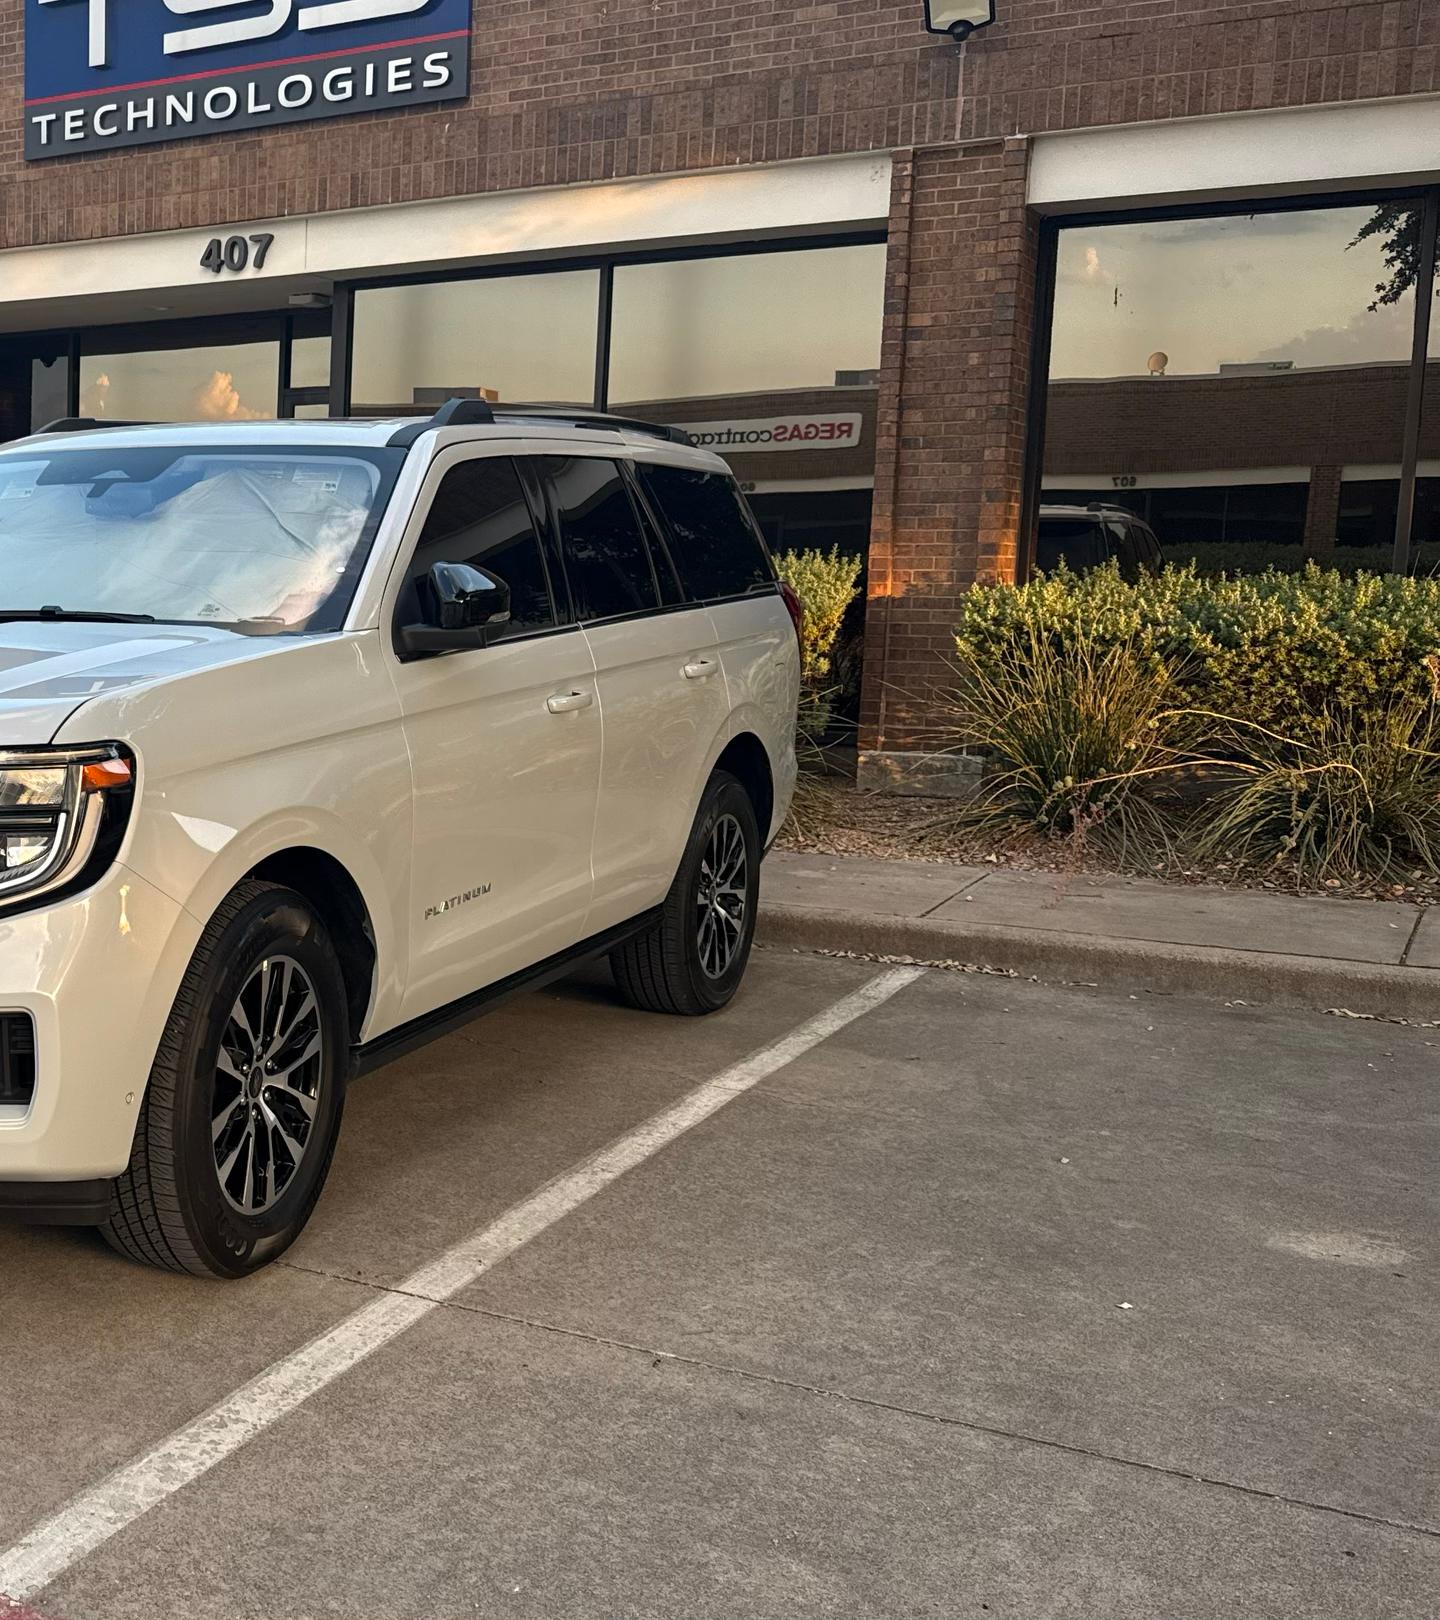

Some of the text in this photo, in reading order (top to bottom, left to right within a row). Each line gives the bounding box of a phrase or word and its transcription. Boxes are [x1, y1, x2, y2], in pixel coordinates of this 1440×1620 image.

[31, 51, 450, 145] TECHNOLOGIES
[200, 233, 275, 274] 407
[424, 882, 492, 920] PLATINUM
